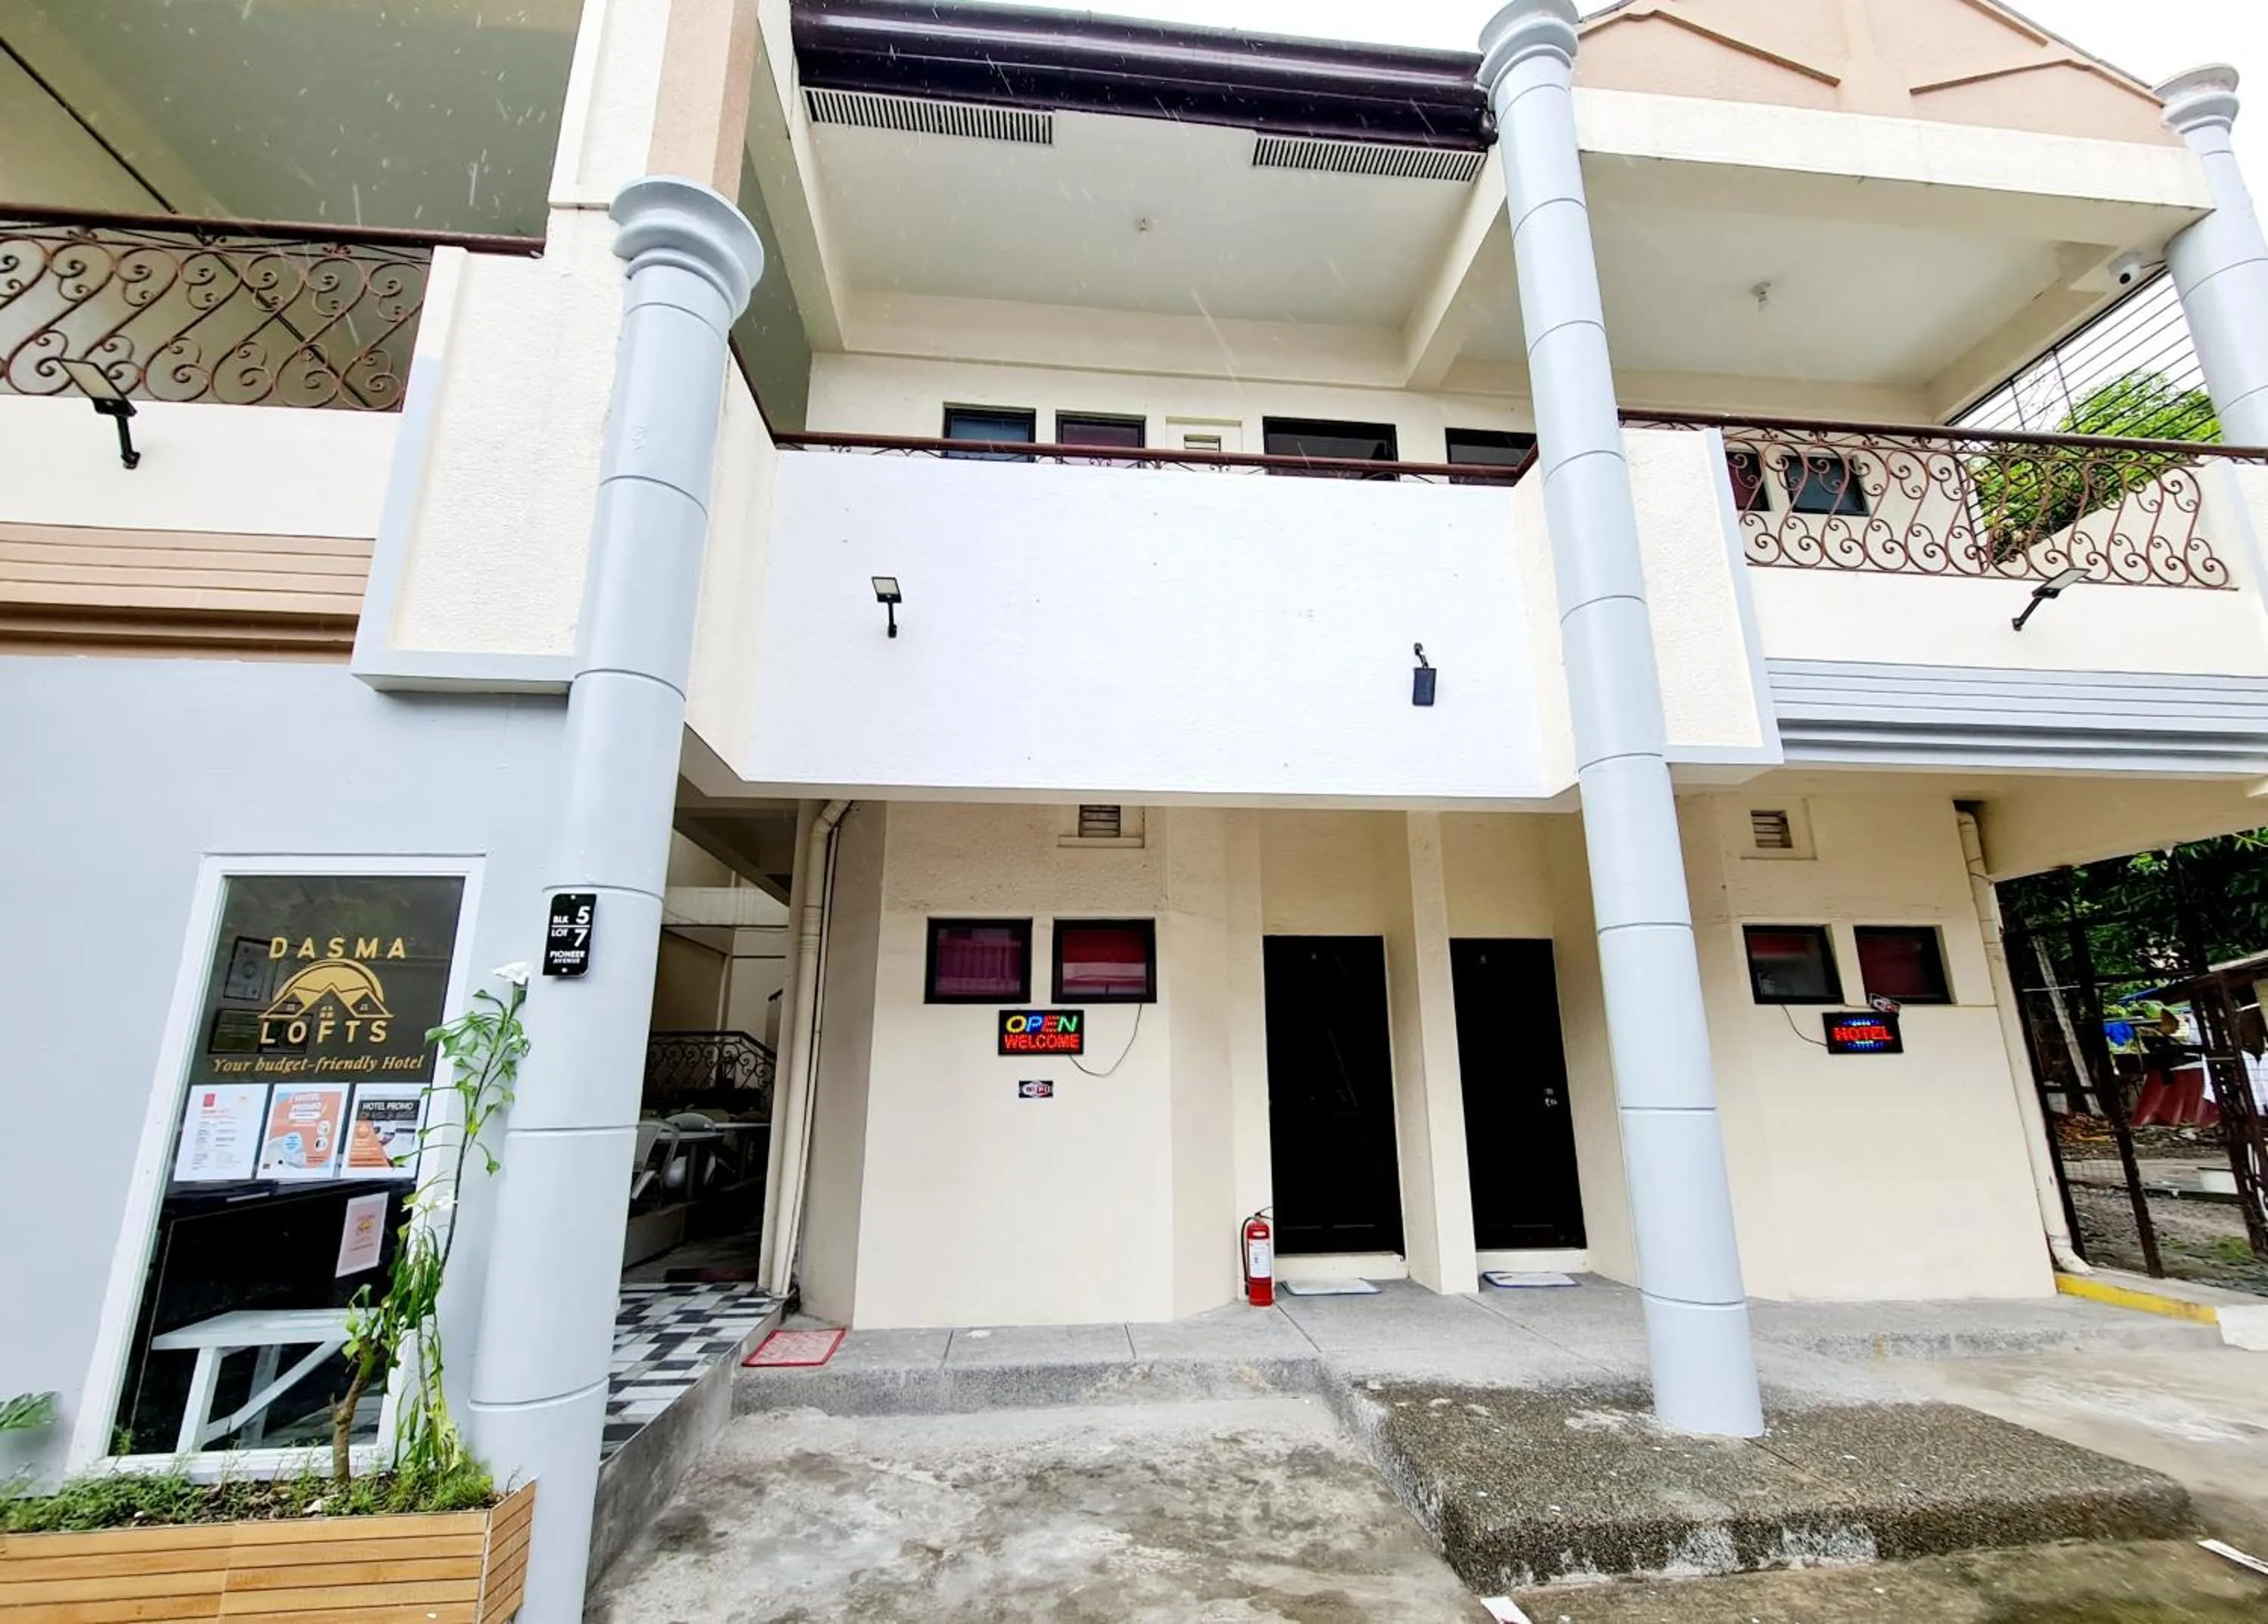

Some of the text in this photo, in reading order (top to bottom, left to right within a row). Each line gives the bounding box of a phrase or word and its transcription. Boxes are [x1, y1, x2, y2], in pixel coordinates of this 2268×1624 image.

[575, 906, 590, 924] 5
[575, 928, 588, 947] 7
[268, 937, 406, 959] DASMA
[259, 1020, 389, 1044] LOFTS
[1005, 1015, 1078, 1034] OPEN
[1833, 1026, 1894, 1041] HOTEL
[1004, 1034, 1080, 1049] WELCOME
[212, 1055, 424, 1074] Your budget-friendly Hotel
